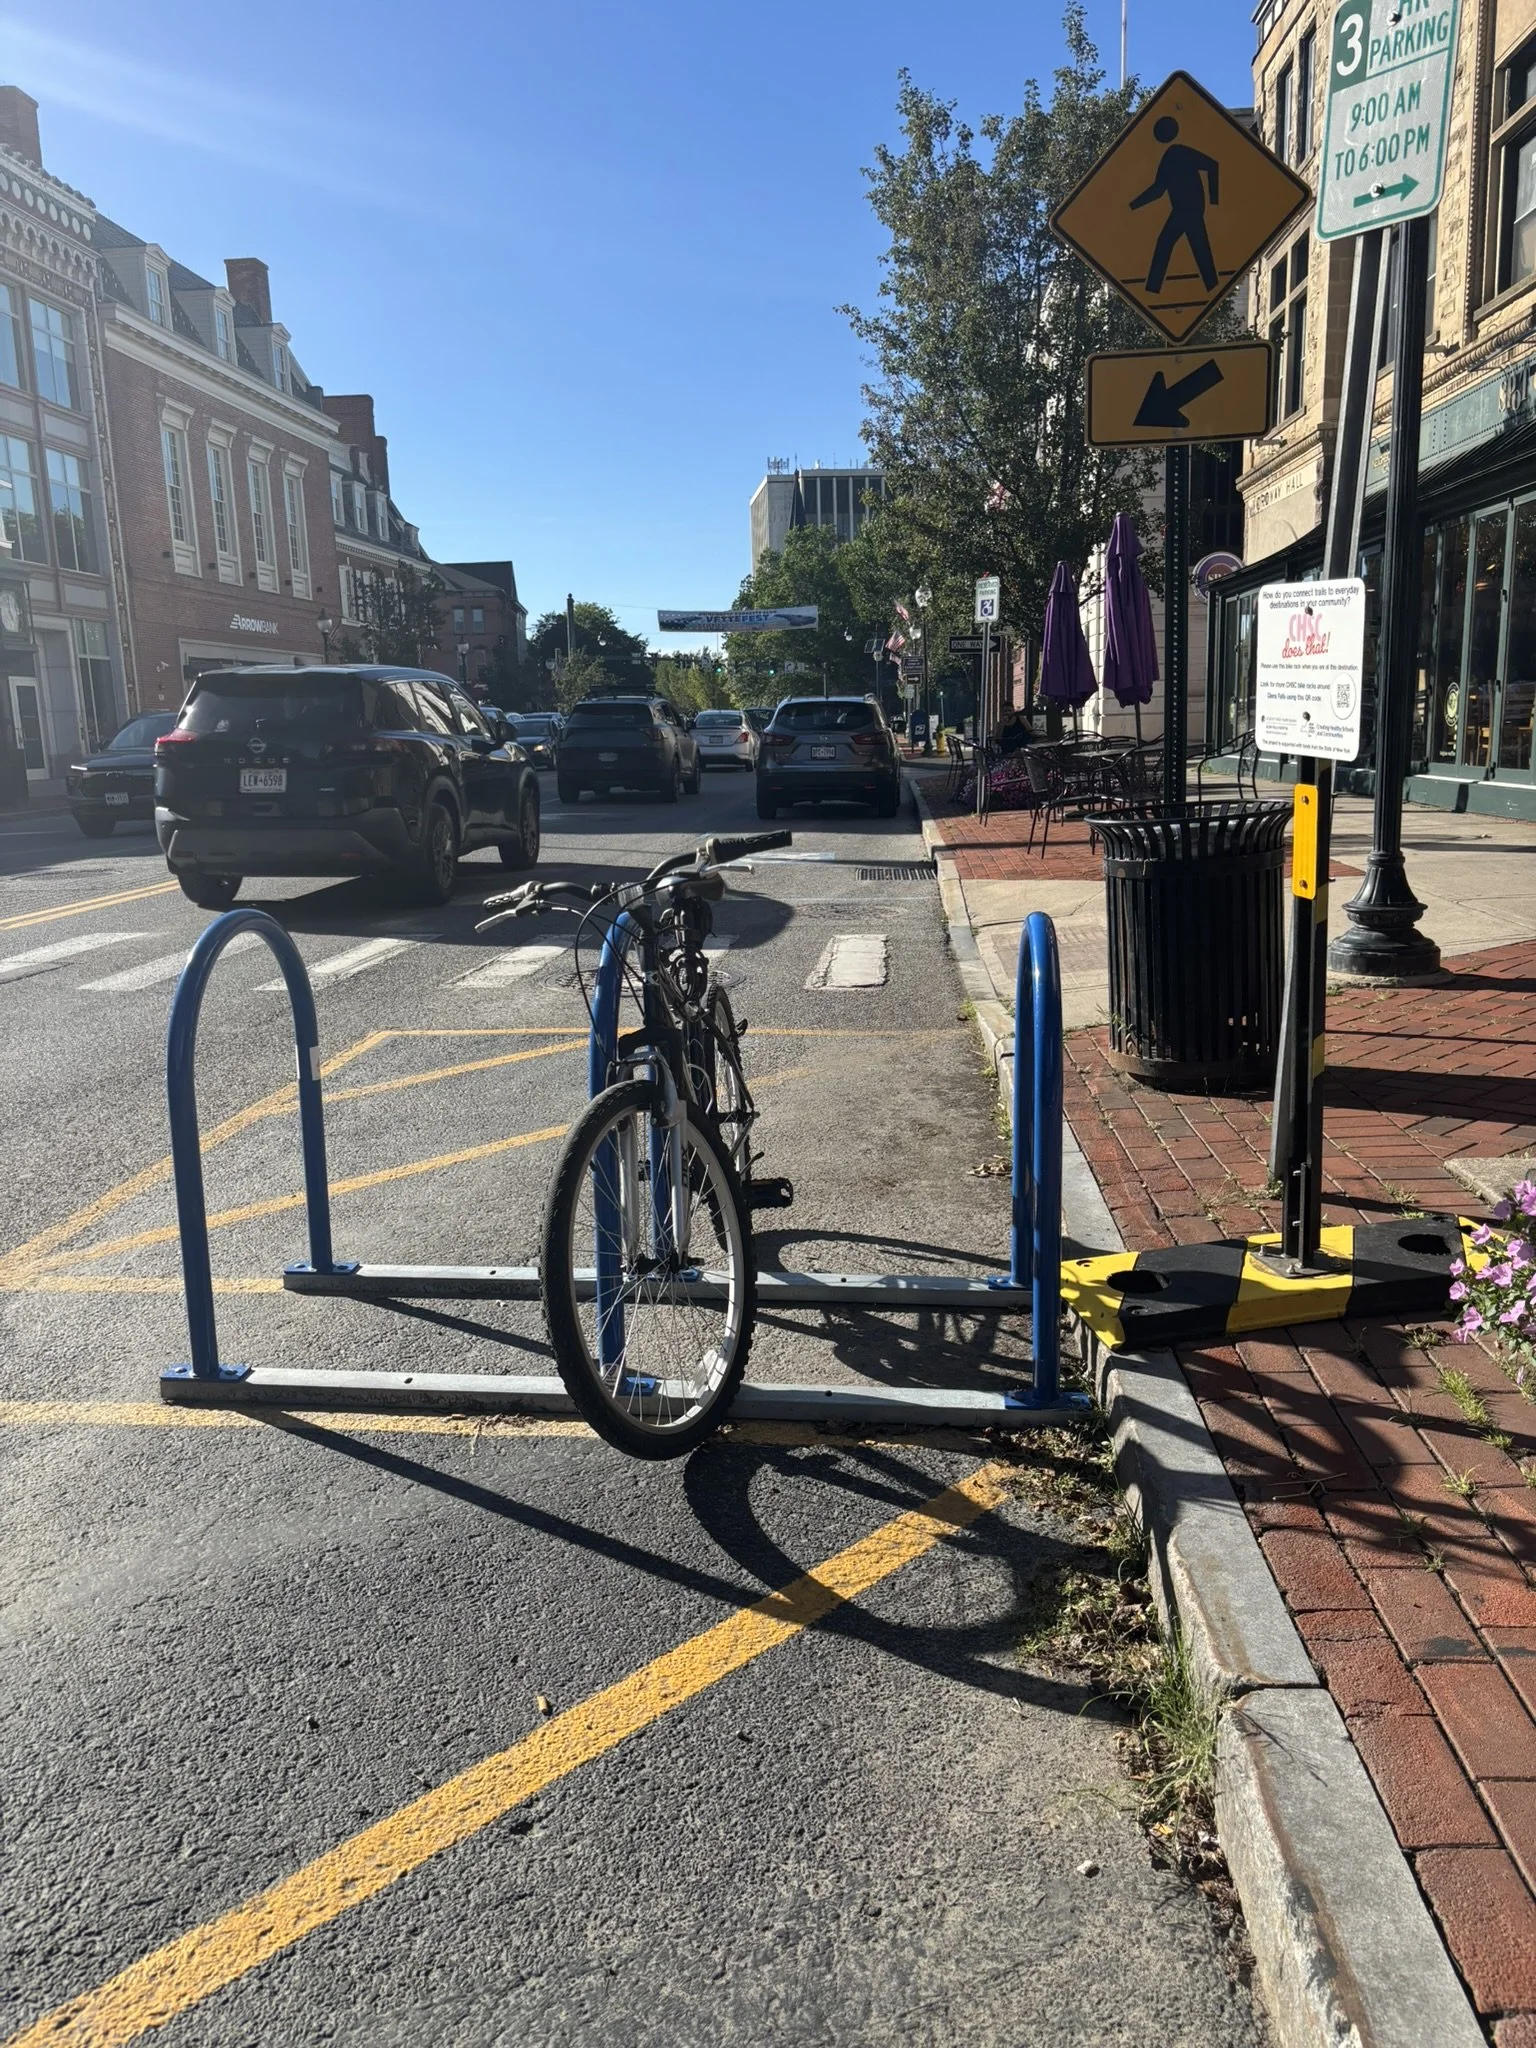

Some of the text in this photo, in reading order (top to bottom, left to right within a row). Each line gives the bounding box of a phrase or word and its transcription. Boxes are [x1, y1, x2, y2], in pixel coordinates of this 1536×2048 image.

[1336, 13, 1363, 76] 3
[1369, 10, 1450, 69] PARKING
[1351, 80, 1422, 132] 9:00 AM
[1335, 123, 1430, 181] TO 6:00 PM
[1263, 591, 1273, 599] How
[1275, 590, 1281, 598] do
[1283, 591, 1292, 601] you
[1293, 588, 1313, 598] connect
[1335, 586, 1359, 597] everyday
[1270, 601, 1298, 609] destinations
[1282, 632, 1331, 659] does that!
[1289, 613, 1323, 642] CHSC
